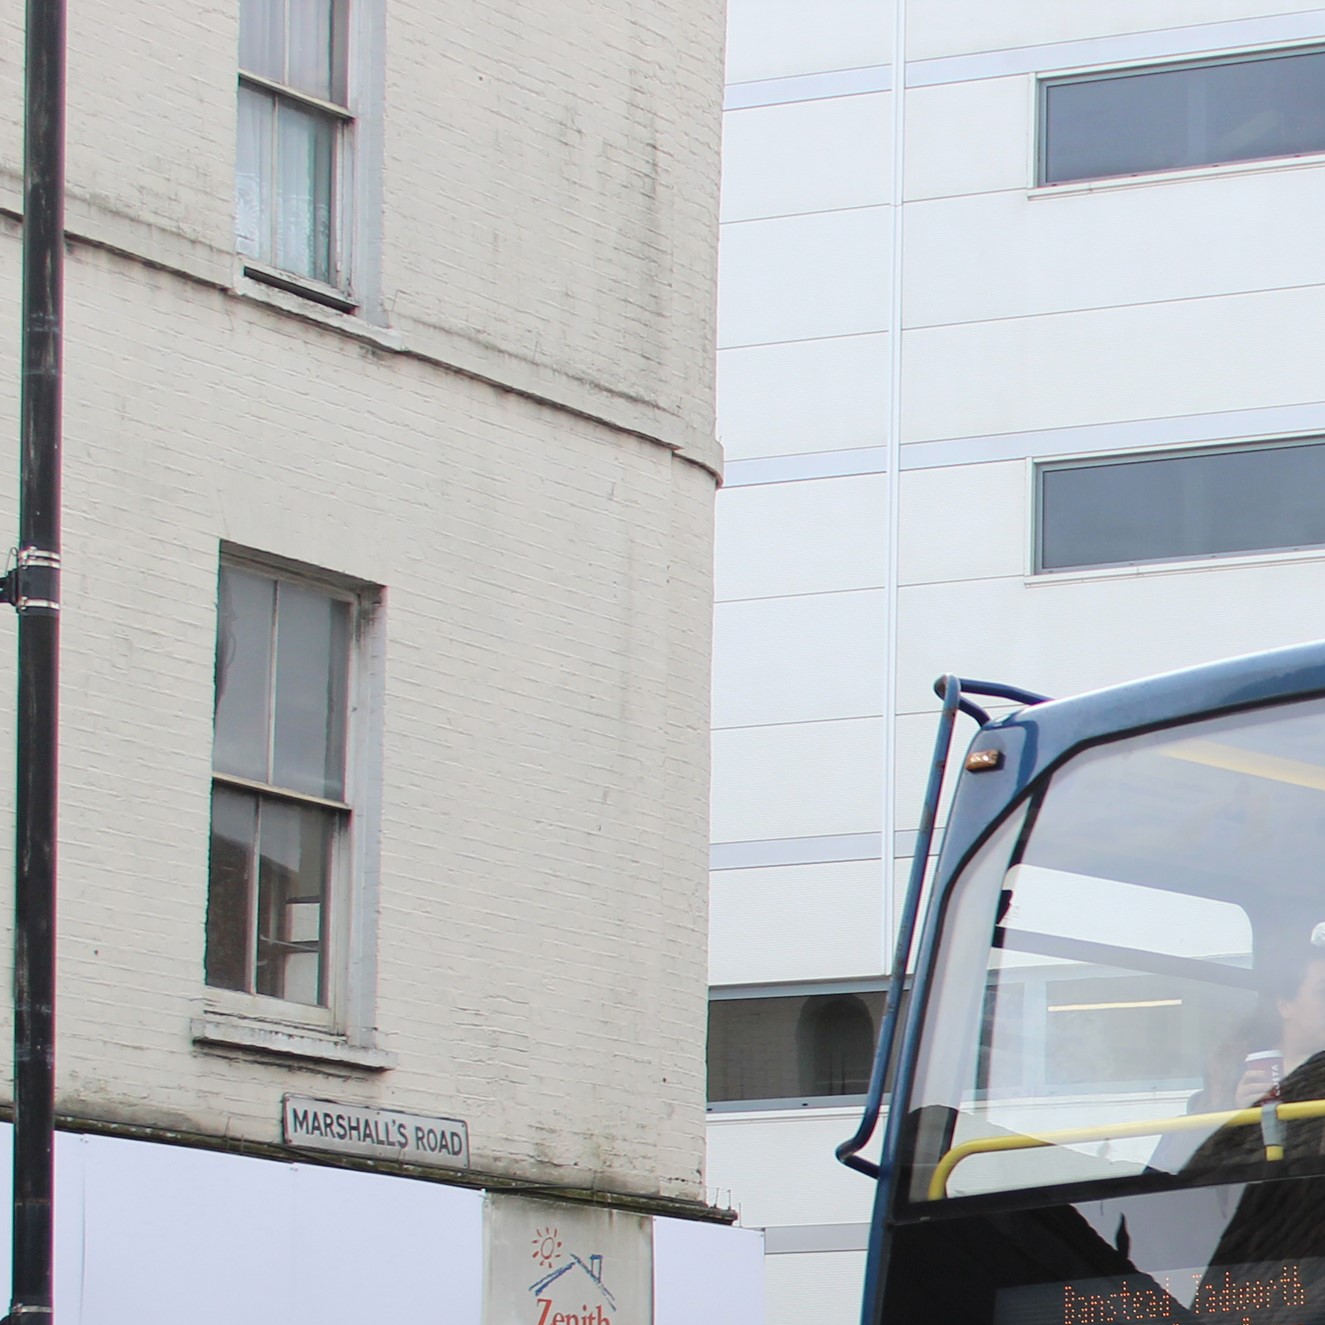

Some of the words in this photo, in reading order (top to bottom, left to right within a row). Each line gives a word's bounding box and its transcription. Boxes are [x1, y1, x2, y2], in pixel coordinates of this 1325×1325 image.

[292, 1107, 409, 1150] MARSHALL'S
[414, 1126, 463, 1157] ROAD
[1063, 1277, 1171, 1325] Banstead
[1192, 1265, 1305, 1315] Tadworth
